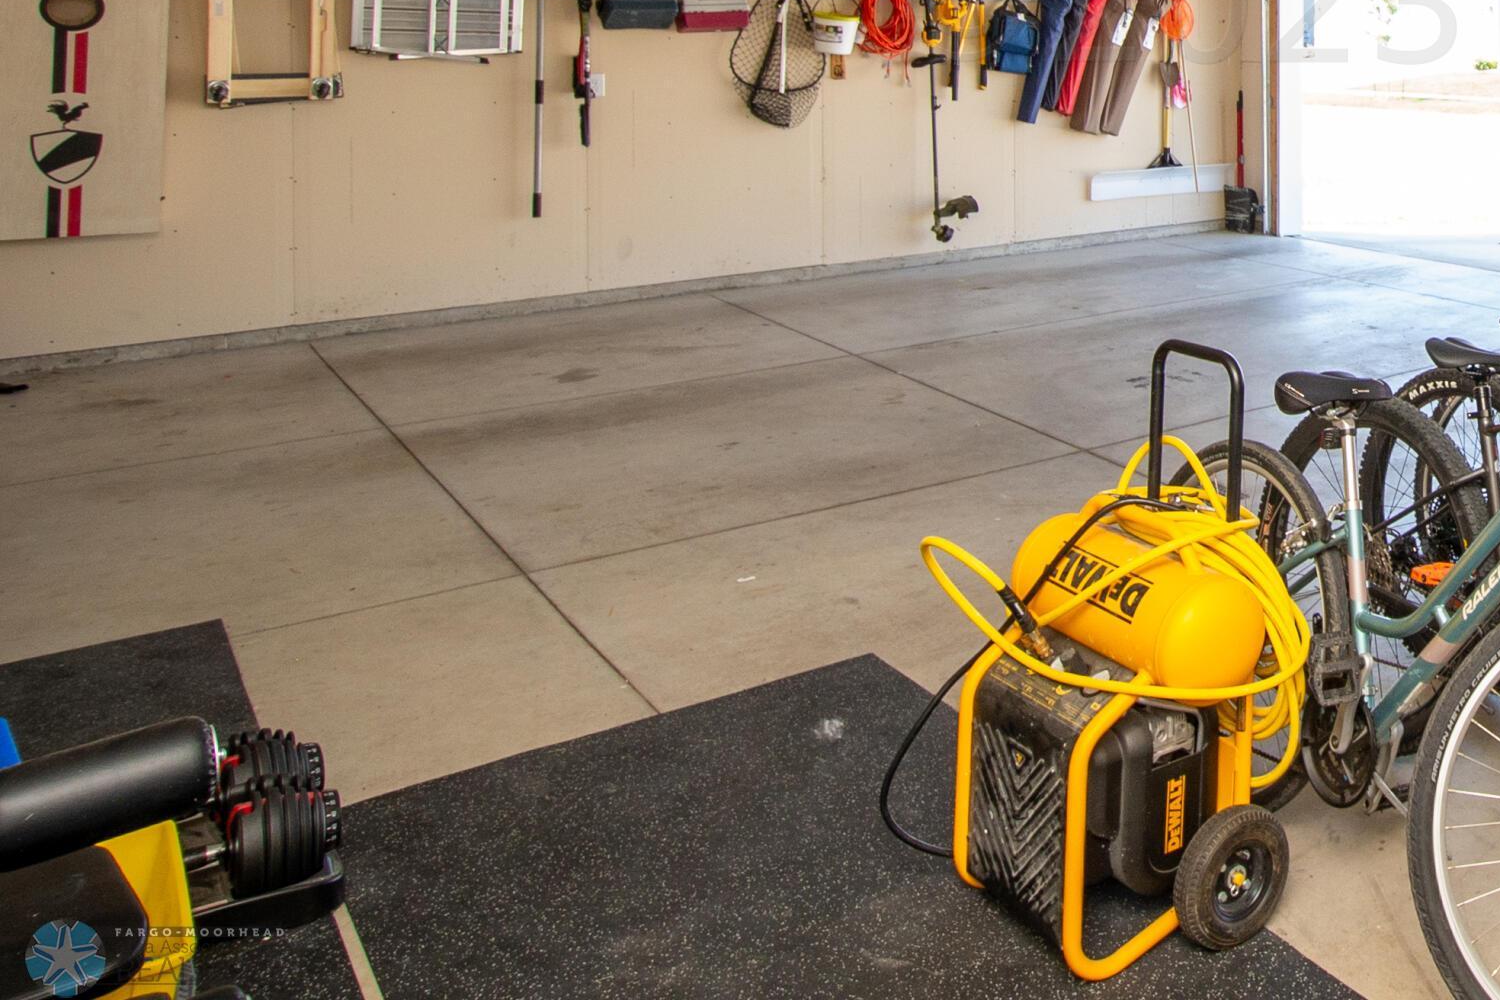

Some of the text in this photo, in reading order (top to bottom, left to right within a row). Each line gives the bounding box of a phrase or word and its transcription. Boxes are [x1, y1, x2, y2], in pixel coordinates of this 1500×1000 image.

[1408, 380, 1458, 400] MAXXIS
[1431, 731, 1449, 782] ARISUN
[1447, 689, 1471, 729] METRO
[1167, 777, 1183, 853] DEWALT
